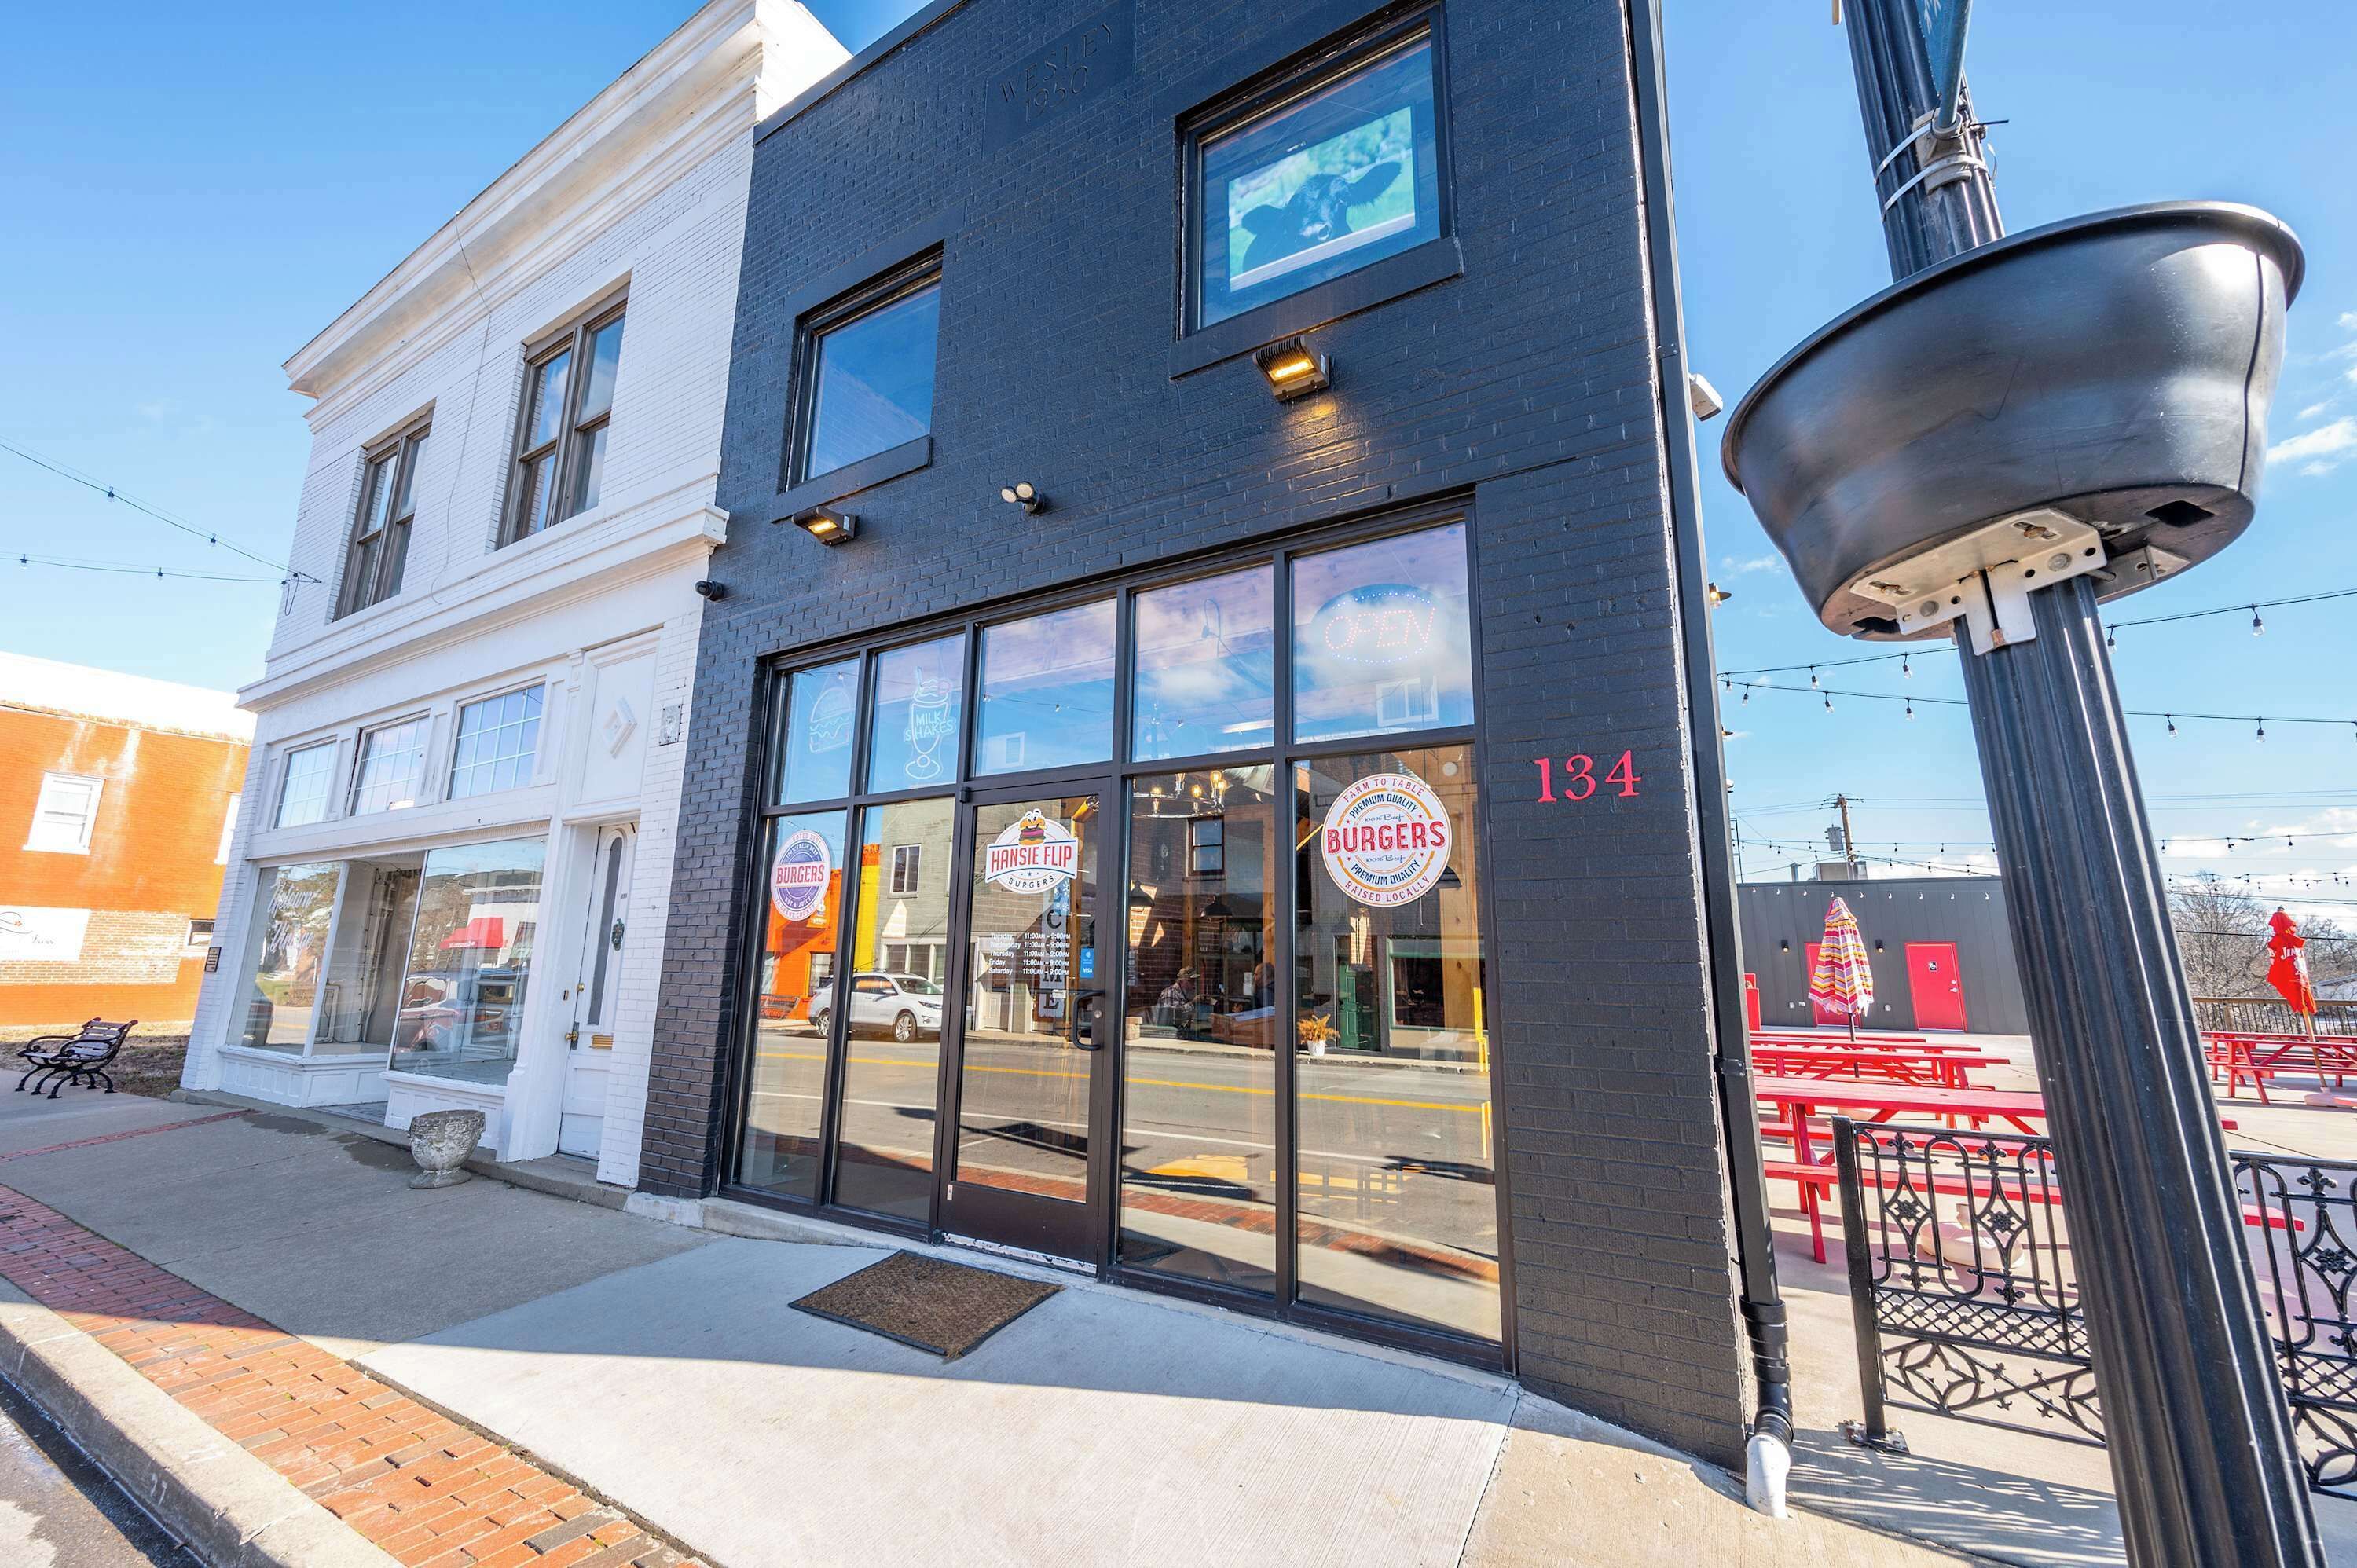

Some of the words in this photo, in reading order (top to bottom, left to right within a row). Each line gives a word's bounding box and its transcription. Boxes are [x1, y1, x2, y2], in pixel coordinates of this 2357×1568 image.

[1325, 606, 1437, 650] OPEN
[904, 716, 956, 742] SHAKES
[915, 710, 942, 725] MILK
[1534, 749, 1642, 804] 134
[1343, 782, 1370, 803] FARM
[1374, 778, 1387, 786] TO
[1392, 779, 1425, 797] TABLE
[1349, 793, 1384, 818] PREMIUM
[1386, 793, 1418, 813] QUALITY
[1382, 813, 1405, 822] Beef
[1327, 821, 1446, 854] BURGERS
[991, 847, 1039, 873] HANSIE
[1043, 845, 1072, 867] FLIP
[1384, 854, 1406, 863] Beef
[776, 864, 826, 884] BURGERS
[1008, 875, 1055, 888] BURGERS
[1351, 863, 1388, 885] PREMIUM
[1390, 859, 1420, 885] QUALITY
[1344, 881, 1381, 902] RAISED
[1386, 874, 1431, 902] LOCALLY
